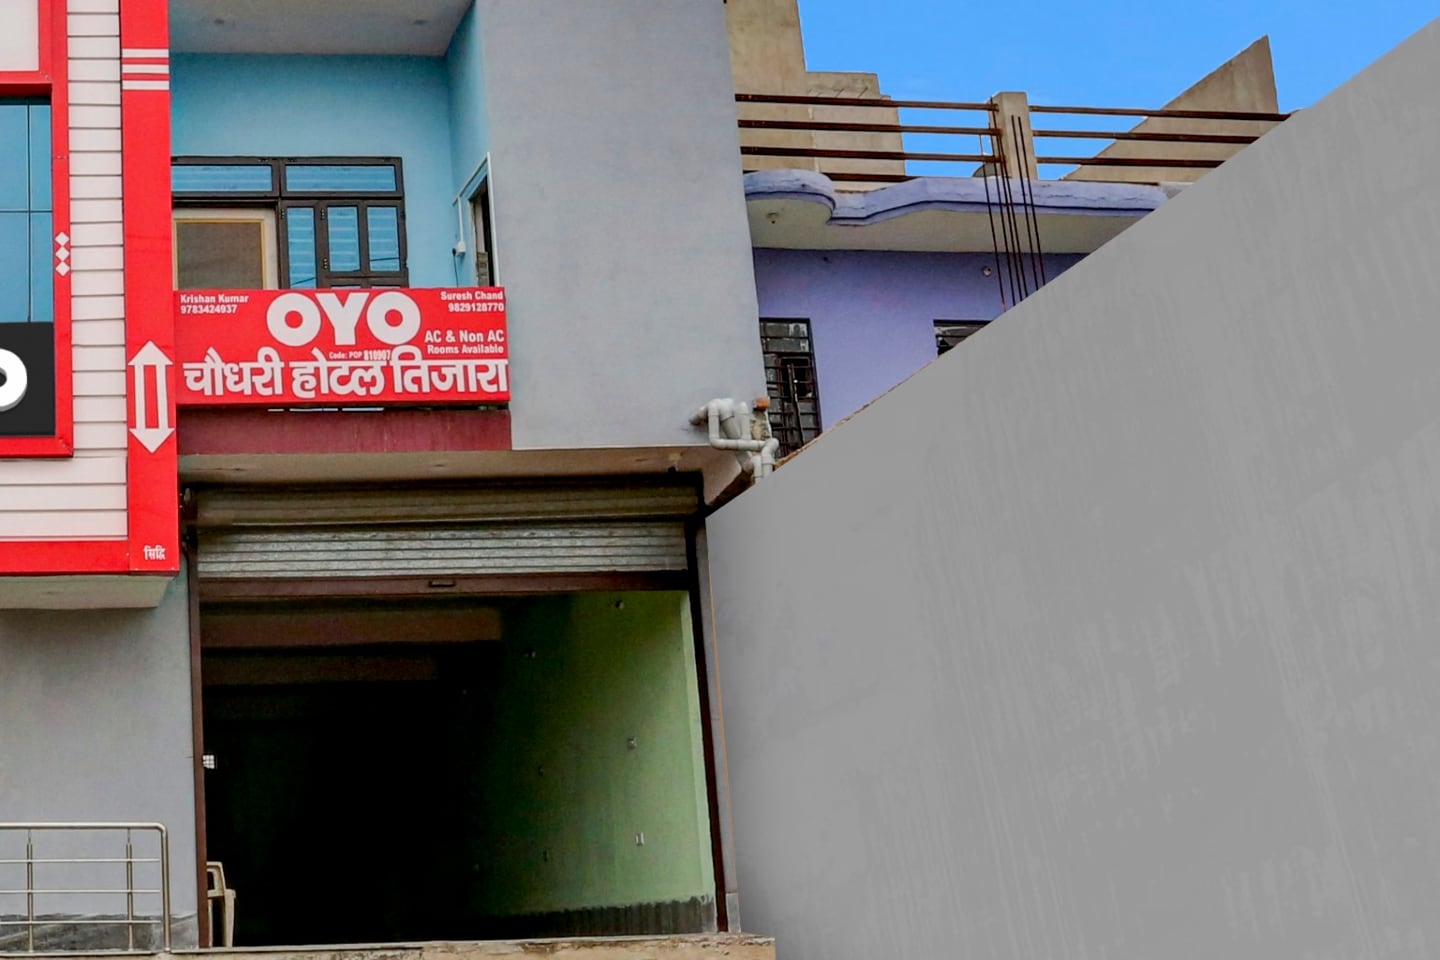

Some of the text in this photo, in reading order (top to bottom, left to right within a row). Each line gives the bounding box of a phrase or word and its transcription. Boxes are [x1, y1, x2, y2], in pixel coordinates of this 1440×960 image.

[180, 293, 249, 304] Krishan Kumar
[440, 290, 504, 300] Suresh Chand
[266, 291, 422, 347] OYO
[424, 329, 505, 343] AC & Non AC
[427, 343, 504, 355] Rooms Available
[183, 345, 509, 399] चौधरी होटल तिजारा
